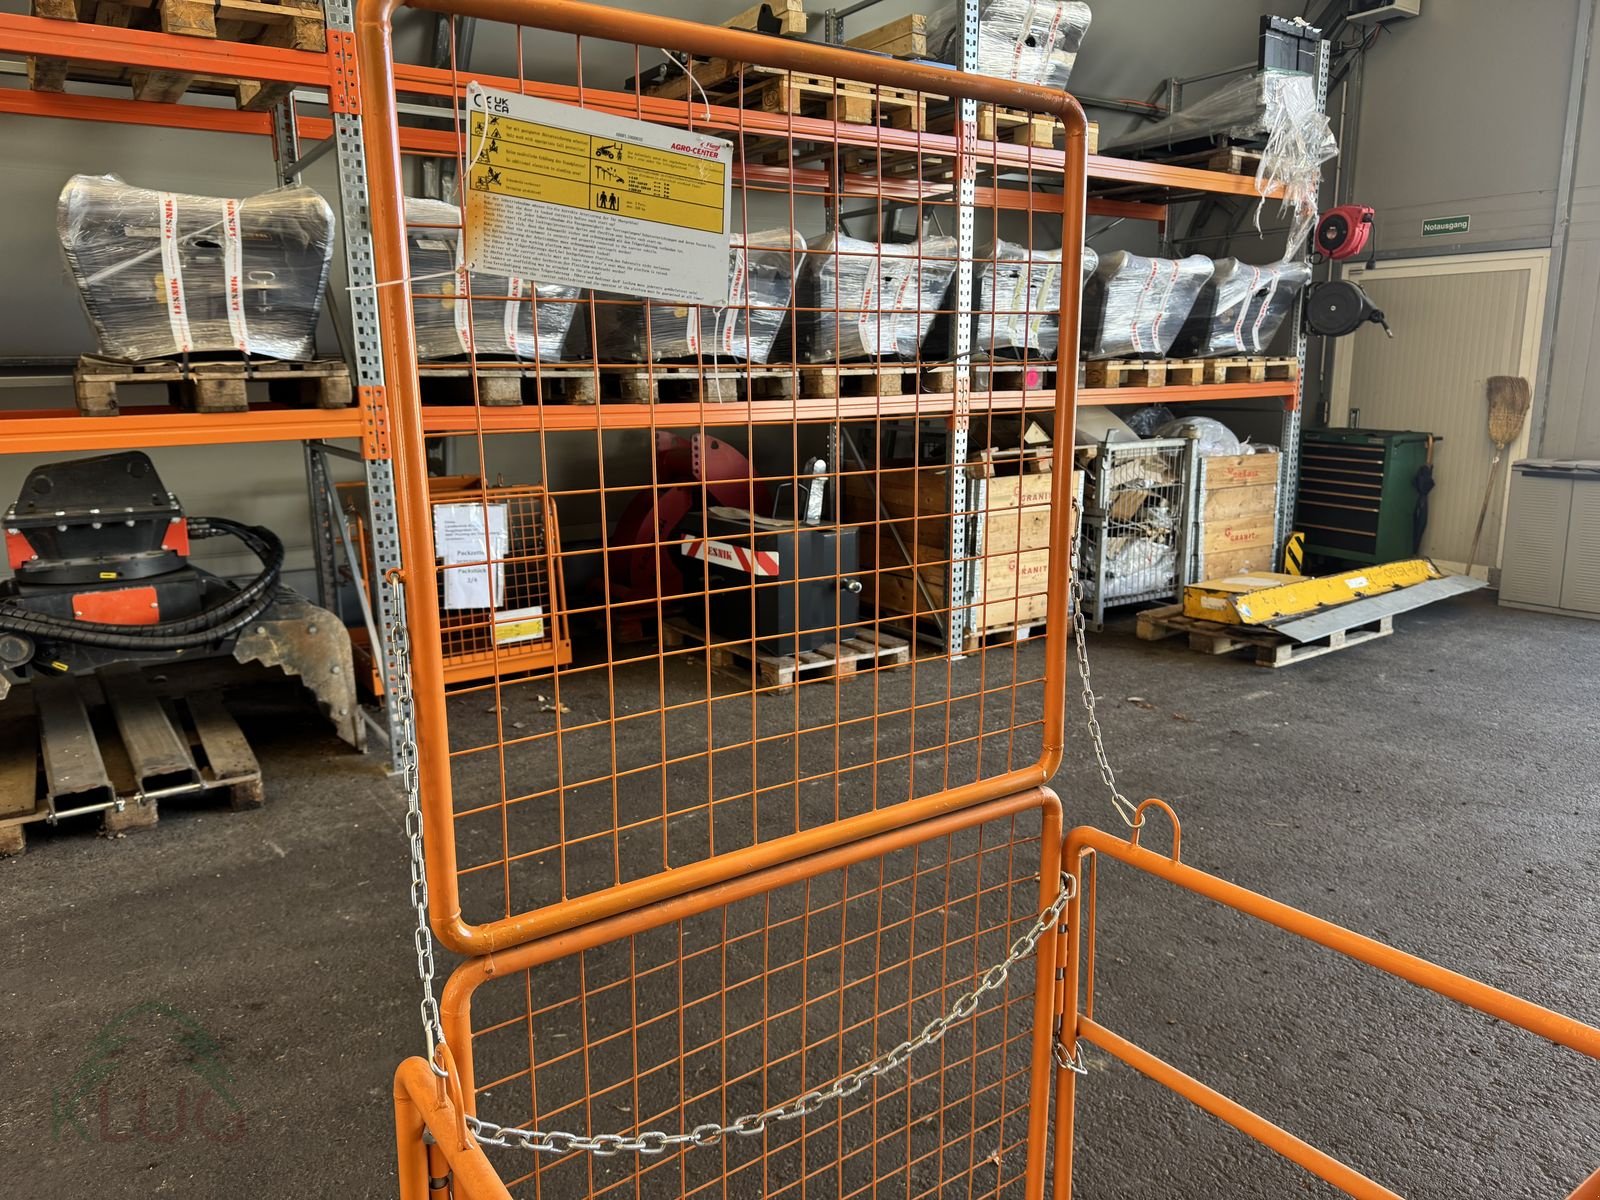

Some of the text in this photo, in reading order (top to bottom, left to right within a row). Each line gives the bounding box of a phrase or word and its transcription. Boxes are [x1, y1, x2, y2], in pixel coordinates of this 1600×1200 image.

[494, 96, 508, 105] UK
[494, 103, 508, 113] CA
[670, 145, 718, 156] AGRO-CENTER
[1424, 221, 1467, 231] Notausgang
[706, 546, 732, 560] ESNIK
[1020, 566, 1047, 575] RANIT
